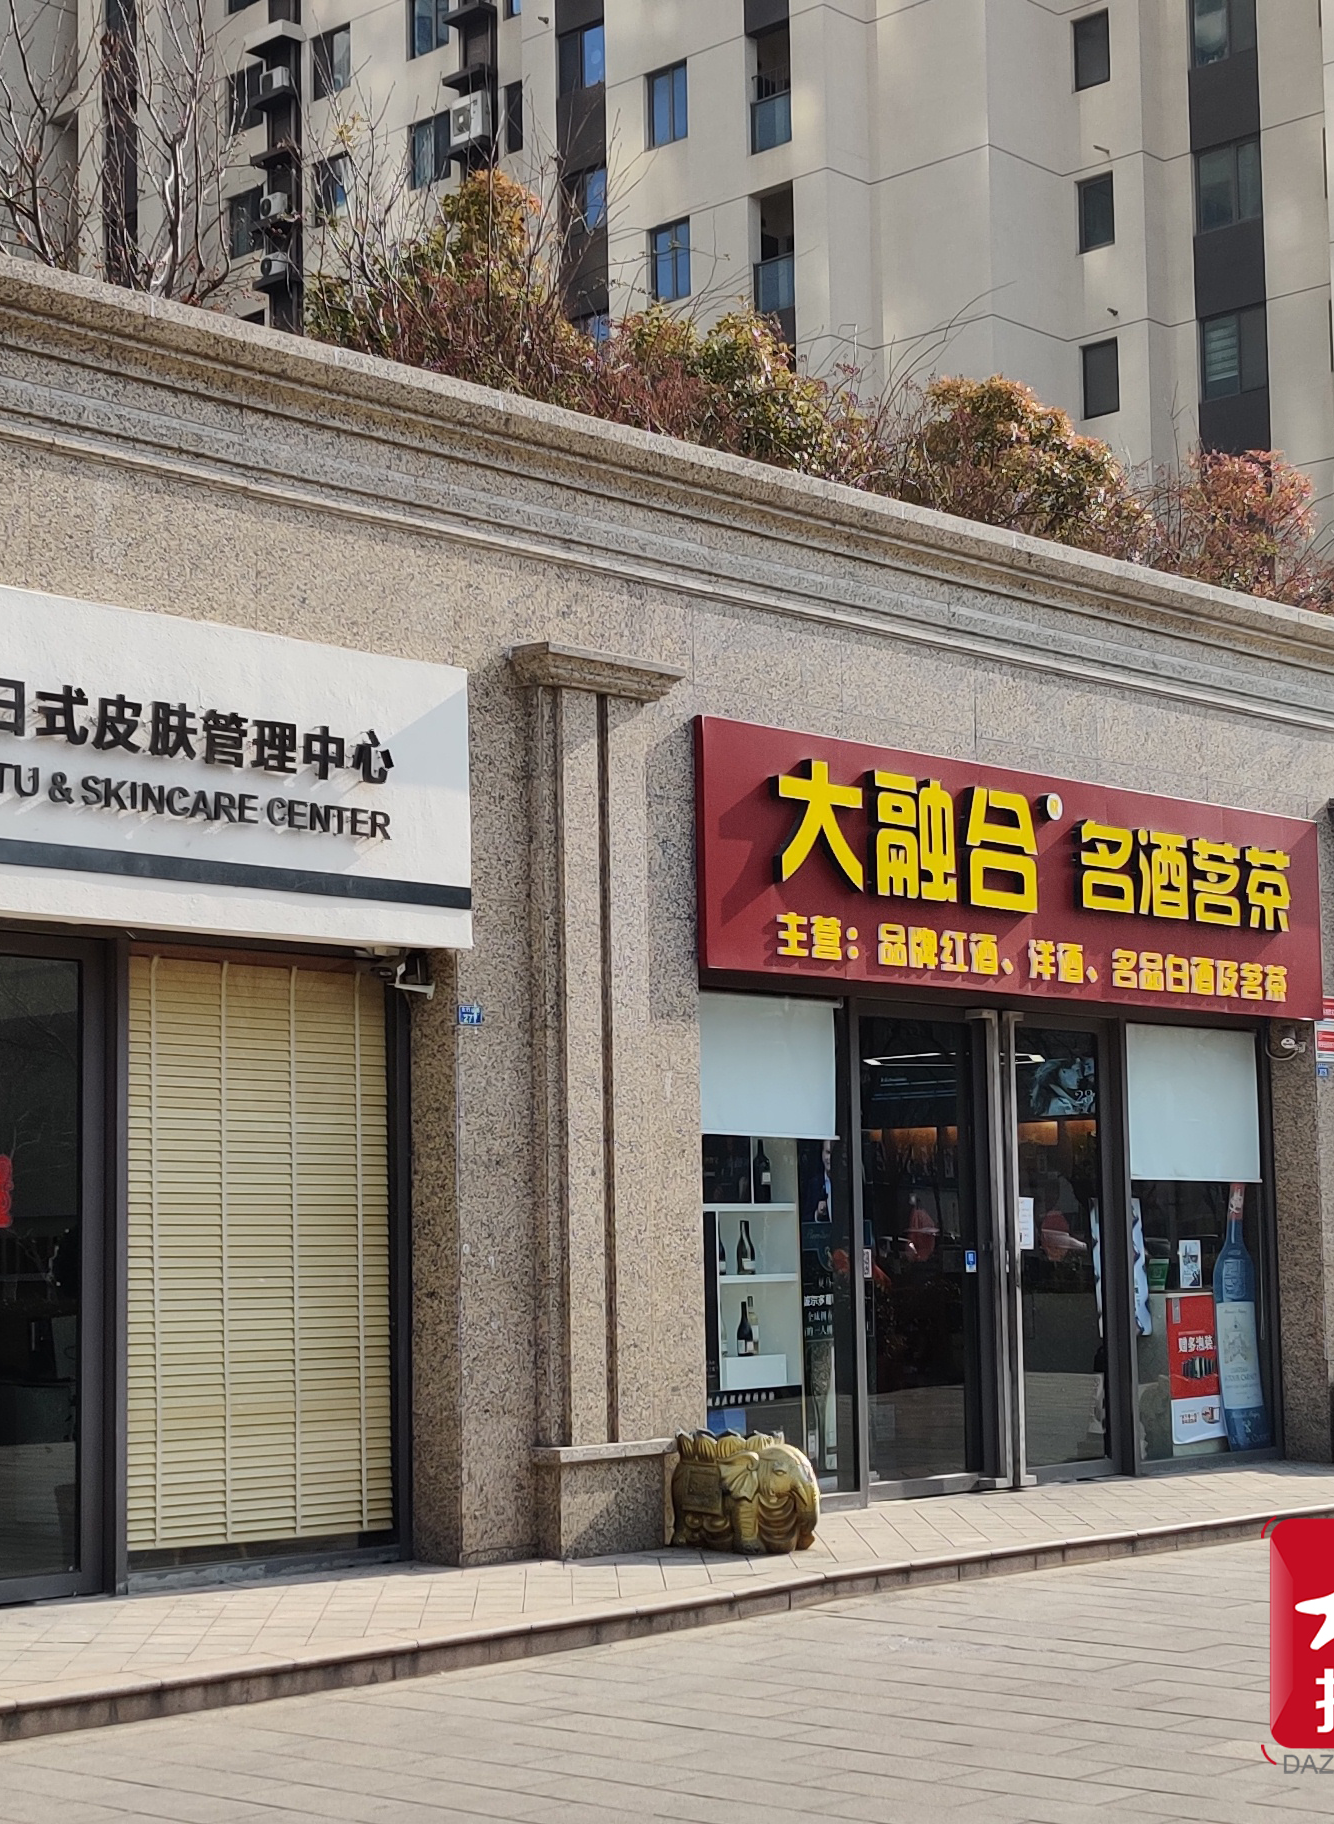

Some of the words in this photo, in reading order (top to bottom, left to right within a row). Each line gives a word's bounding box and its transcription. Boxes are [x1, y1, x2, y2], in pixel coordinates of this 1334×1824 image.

[48, 771, 74, 805] &
[81, 775, 259, 824] SKINCARE
[266, 797, 392, 840] CENTER
[773, 759, 1039, 914] 大融合
[1075, 818, 1292, 932] 名酒茗茶
